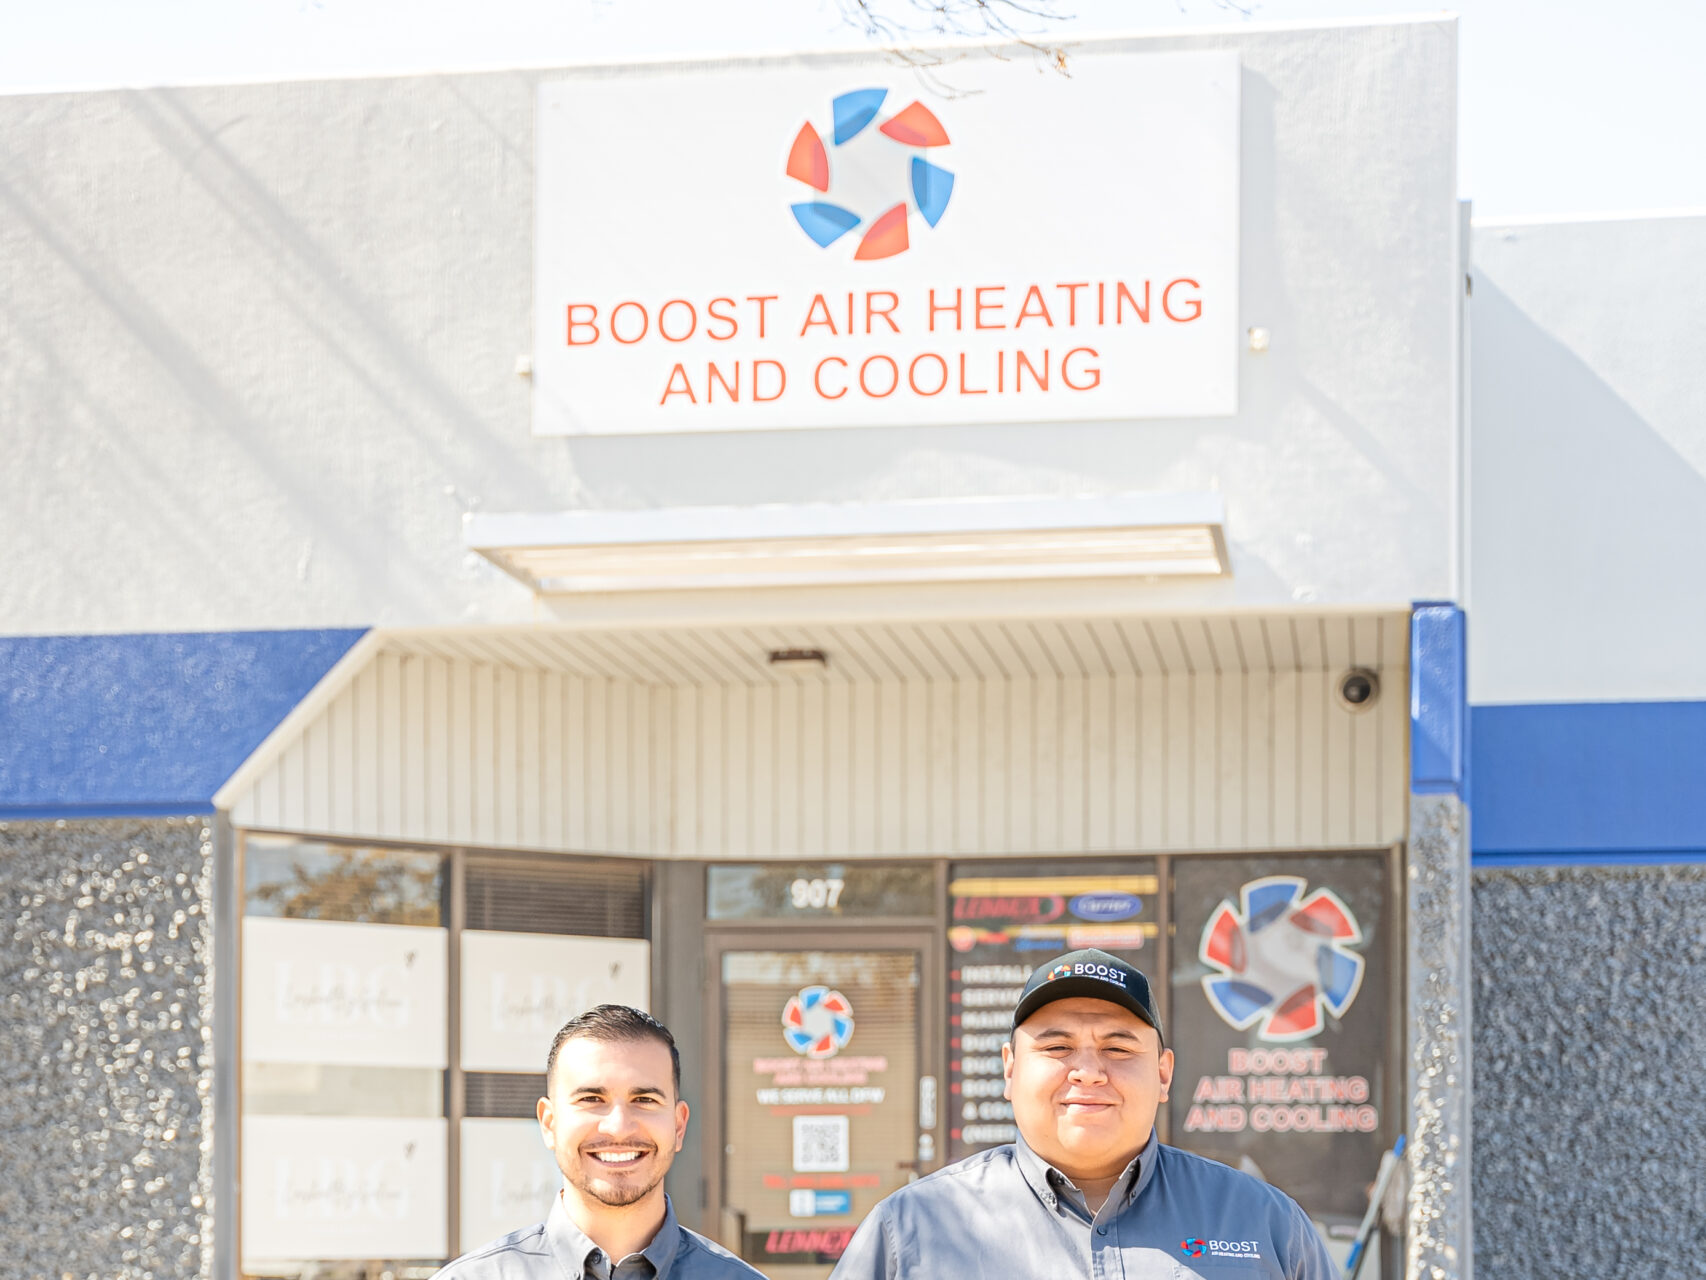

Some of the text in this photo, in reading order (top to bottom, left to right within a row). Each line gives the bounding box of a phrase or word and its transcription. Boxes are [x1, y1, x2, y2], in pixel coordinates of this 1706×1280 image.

[566, 277, 1203, 347] BOOST AIR HEATING
[658, 346, 1101, 406] AND COOLING
[791, 879, 845, 908] 907
[1074, 963, 1127, 982] BOOST
[1228, 1047, 1328, 1075] BOOST
[1193, 1075, 1369, 1104] AIR HEATING
[1184, 1104, 1379, 1132] AND COOLING
[1208, 1240, 1259, 1252] BOOST
